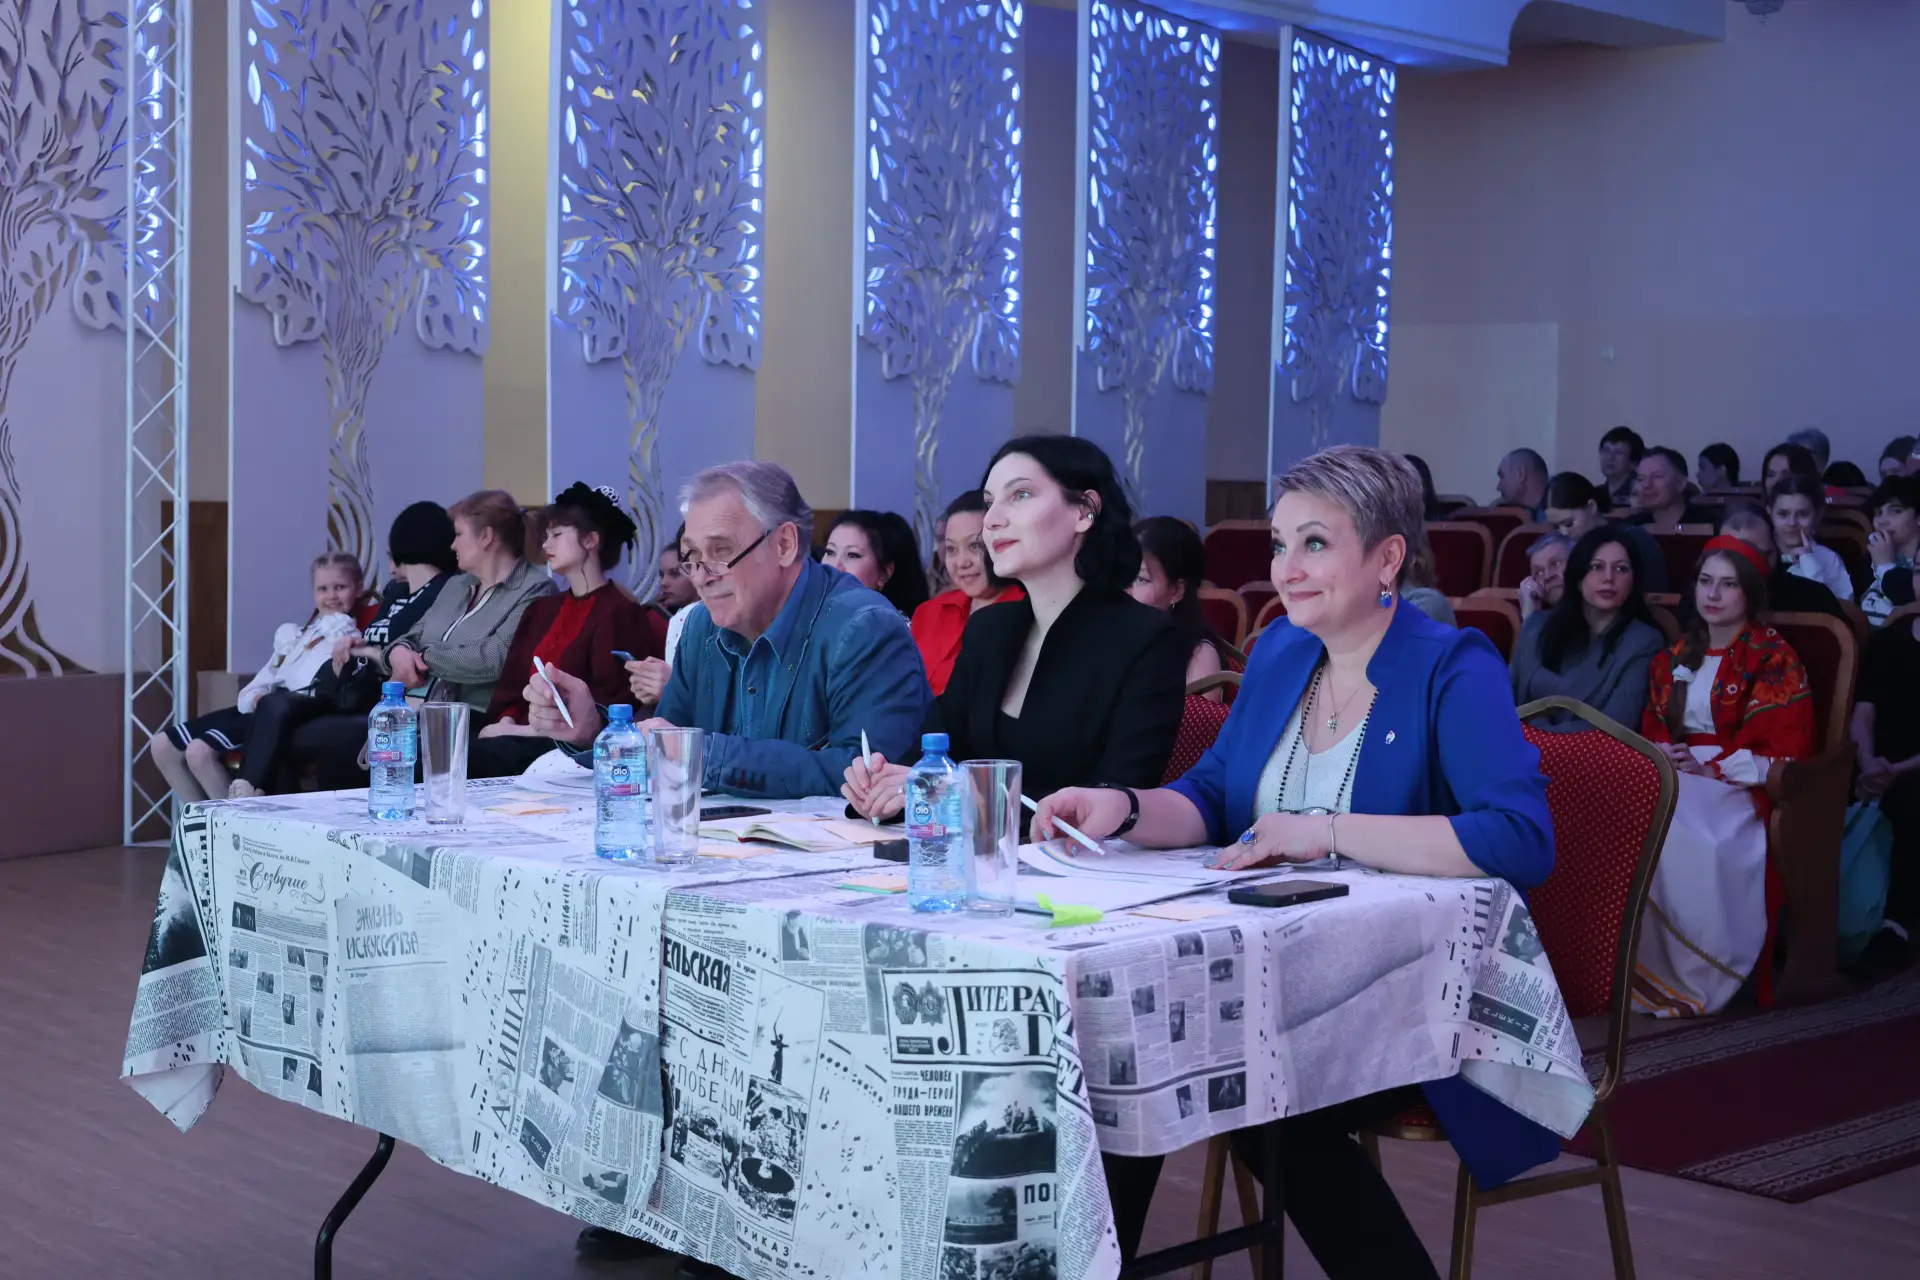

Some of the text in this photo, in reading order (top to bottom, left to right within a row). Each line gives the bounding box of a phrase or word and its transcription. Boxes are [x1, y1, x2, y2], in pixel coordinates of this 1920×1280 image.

[613, 767, 628, 776] dio
[356, 903, 403, 932] ЖИЗНЬ
[346, 930, 420, 960] ИСКУССТВА
[661, 934, 732, 996] ЕЛЬСКАЯ
[679, 1036, 689, 1059] С
[919, 1069, 952, 1083] ЧЕЛОВЕК
[893, 1103, 953, 1118] НАШЕГО ВРЕМЕНИ
[591, 1109, 603, 1157] РАДОСТЬ
[632, 1208, 679, 1243] ВЕЛИКИЙ
[736, 1220, 790, 1257] ПРИКАЗ
[775, 1256, 789, 1270] СССР
